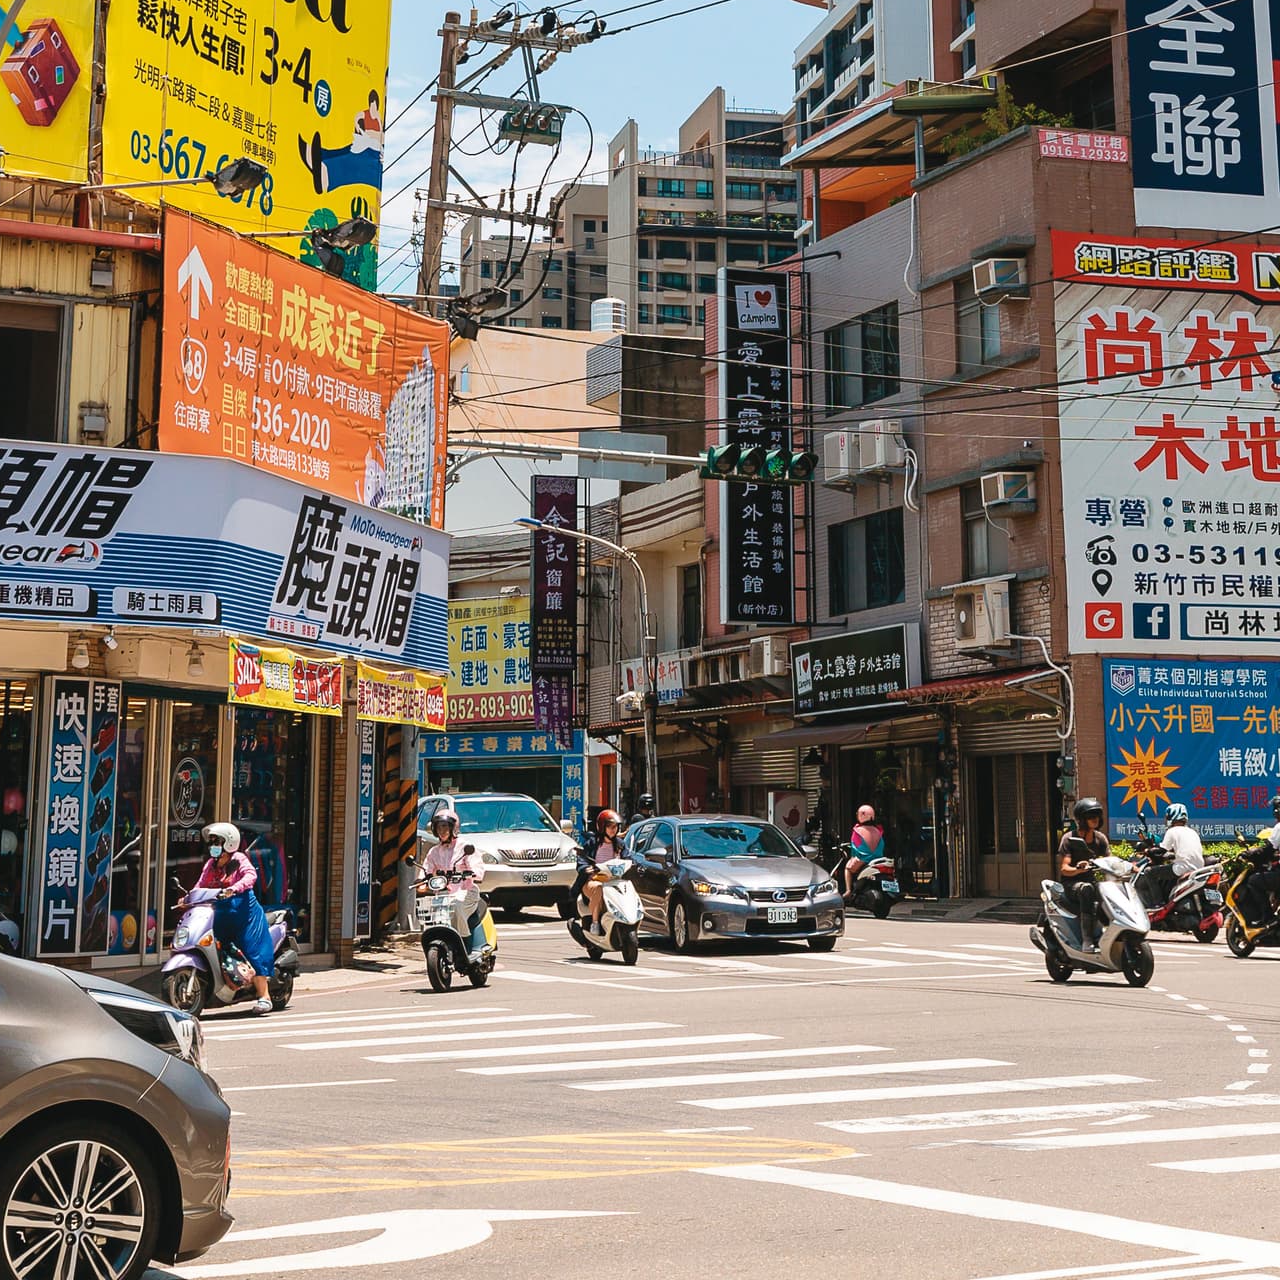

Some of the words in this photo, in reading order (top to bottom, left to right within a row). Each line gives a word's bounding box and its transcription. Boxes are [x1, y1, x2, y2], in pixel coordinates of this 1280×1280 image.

[1041, 144, 1128, 162] 0916-129332
[1077, 243, 1237, 282] 網路評鑑
[225, 261, 274, 305] 歡慶熱銷
[224, 297, 273, 338] 全面動工
[279, 284, 385, 376] 成家近了
[1084, 311, 1271, 393] 尚林
[174, 400, 211, 435] 往南寮
[251, 396, 331, 451] 536-2020
[251, 439, 331, 481] 東大路四段133號旁
[1084, 496, 1147, 529] 專營
[376, 525, 413, 551] Headgear
[275, 494, 420, 647] 魔頭帽
[127, 590, 205, 616] 騎士雨具
[237, 656, 261, 686] SALE
[1137, 666, 1267, 687] 菁英個別指導學院
[94, 684, 118, 714] 手套
[1138, 688, 1159, 697] Elite
[1160, 689, 1203, 698] Individual
[1204, 689, 1238, 699] Tutorial
[1238, 690, 1268, 699] School
[1129, 760, 1161, 776] 完全
[1131, 778, 1163, 793] 免費
[44, 691, 87, 941] 快速換鏡片
